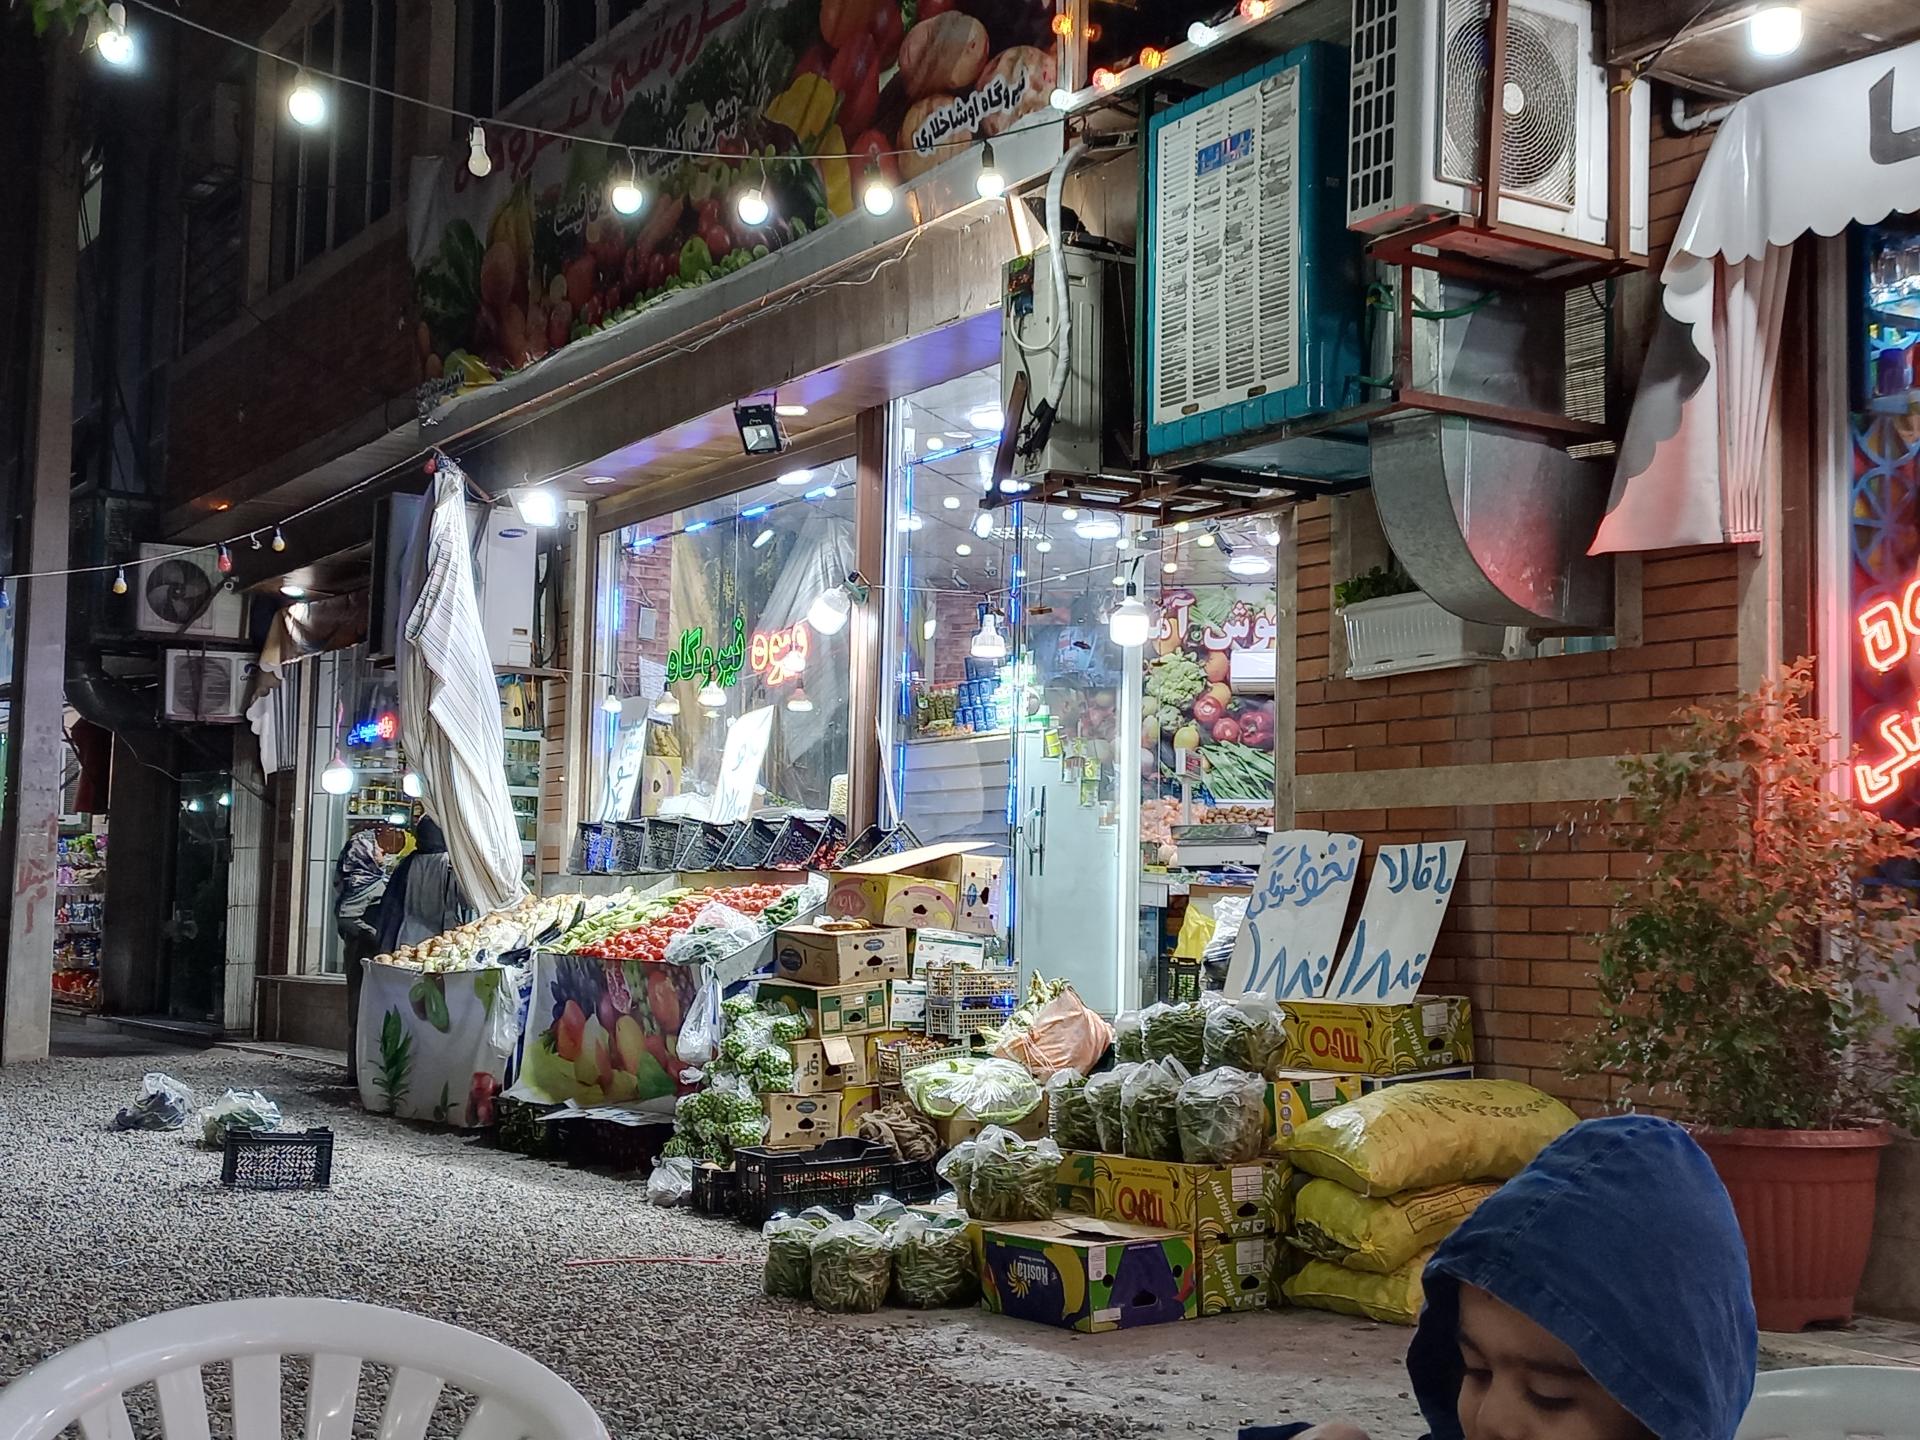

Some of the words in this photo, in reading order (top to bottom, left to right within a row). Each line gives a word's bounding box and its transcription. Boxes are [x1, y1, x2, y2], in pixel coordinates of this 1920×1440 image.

[600, 0, 748, 125] روشی
[981, 70, 1027, 113] نیروگاه
[453, 84, 600, 194] نیروگه
[1203, 600, 1277, 650] وش
[665, 615, 746, 691] نیروگاه
[1401, 1016, 1425, 1057] HEALTHY
[1208, 1179, 1233, 1224] HEALTHY
[1016, 1261, 1050, 1287] Rosita
[1214, 1252, 1236, 1297] HEALTHY
